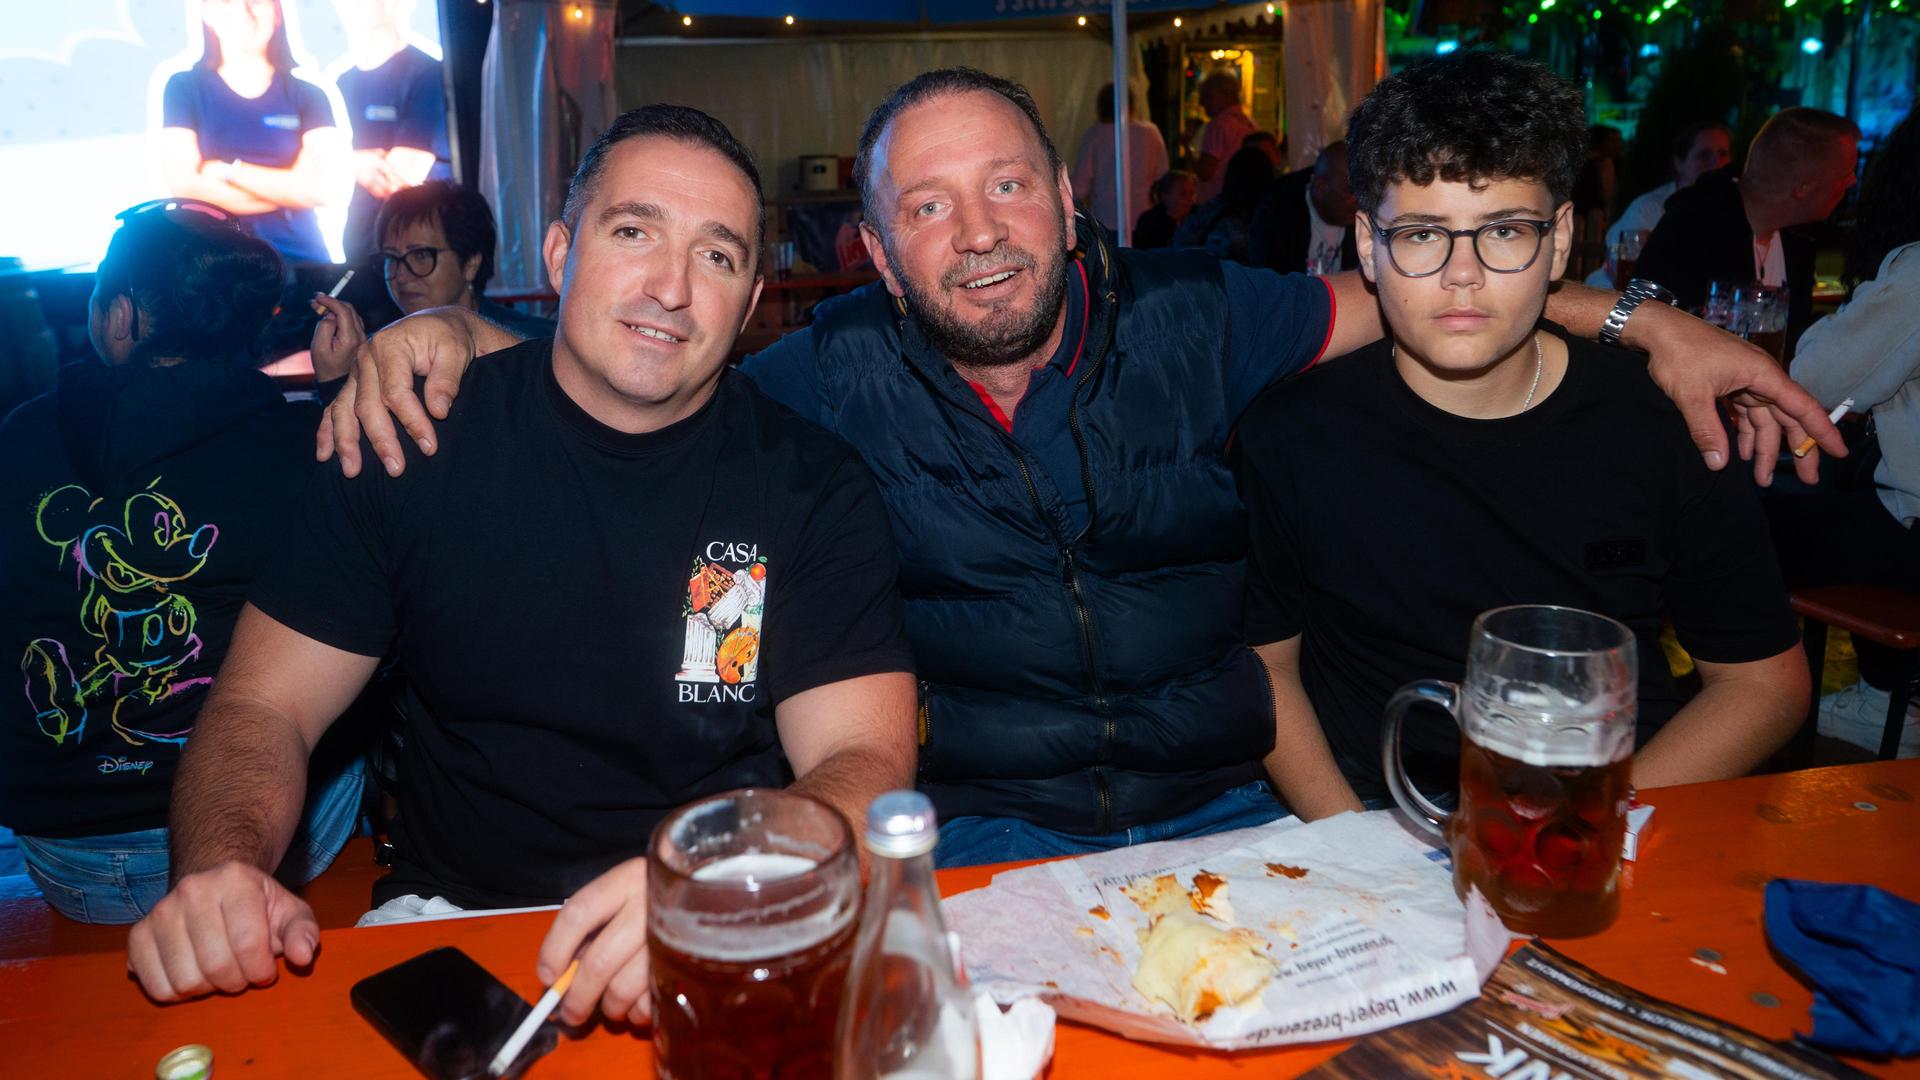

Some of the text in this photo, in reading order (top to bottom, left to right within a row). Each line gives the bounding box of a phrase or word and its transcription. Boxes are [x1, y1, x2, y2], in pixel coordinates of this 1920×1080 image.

[706, 541, 758, 564] CASA
[678, 683, 756, 703] BLANC
[96, 754, 154, 776] Disney
